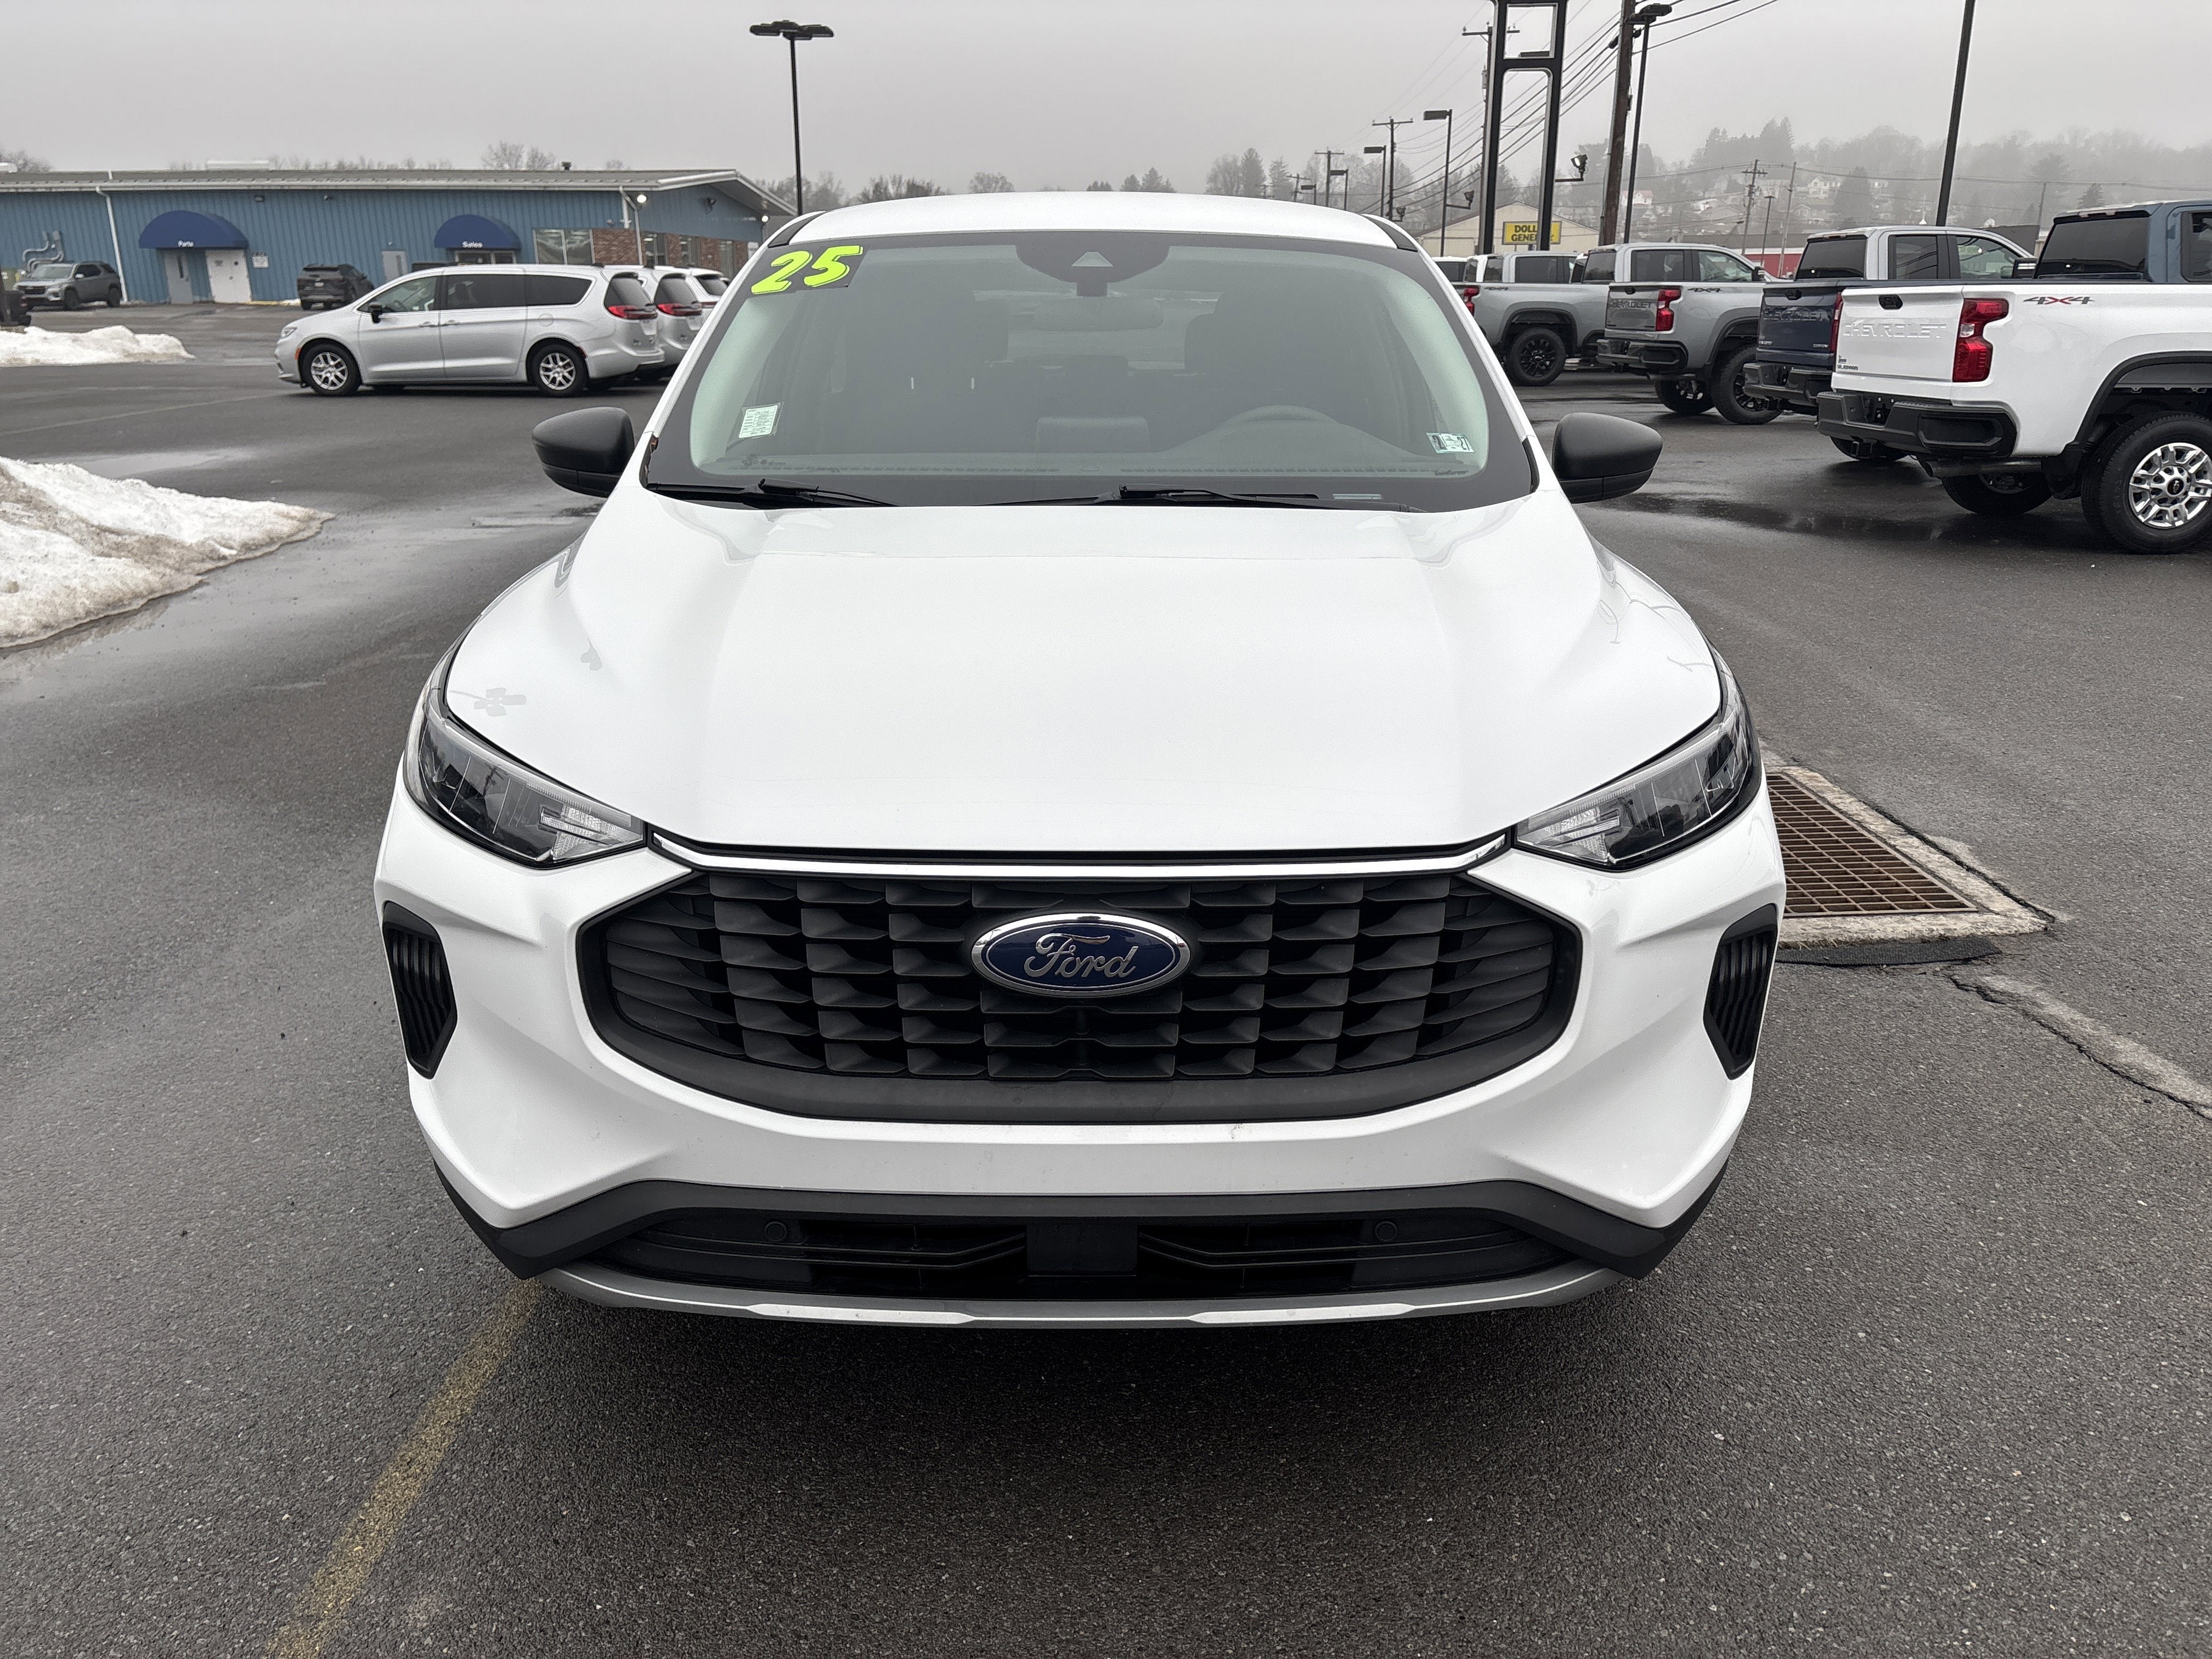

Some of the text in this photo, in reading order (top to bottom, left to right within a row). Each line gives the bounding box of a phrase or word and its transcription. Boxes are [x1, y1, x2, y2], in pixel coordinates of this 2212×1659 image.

[1511, 233, 1554, 241] GENE
[751, 245, 864, 295] 25
[1843, 324, 1946, 338] CHEVROLET
[1024, 933, 1139, 978] Ford
